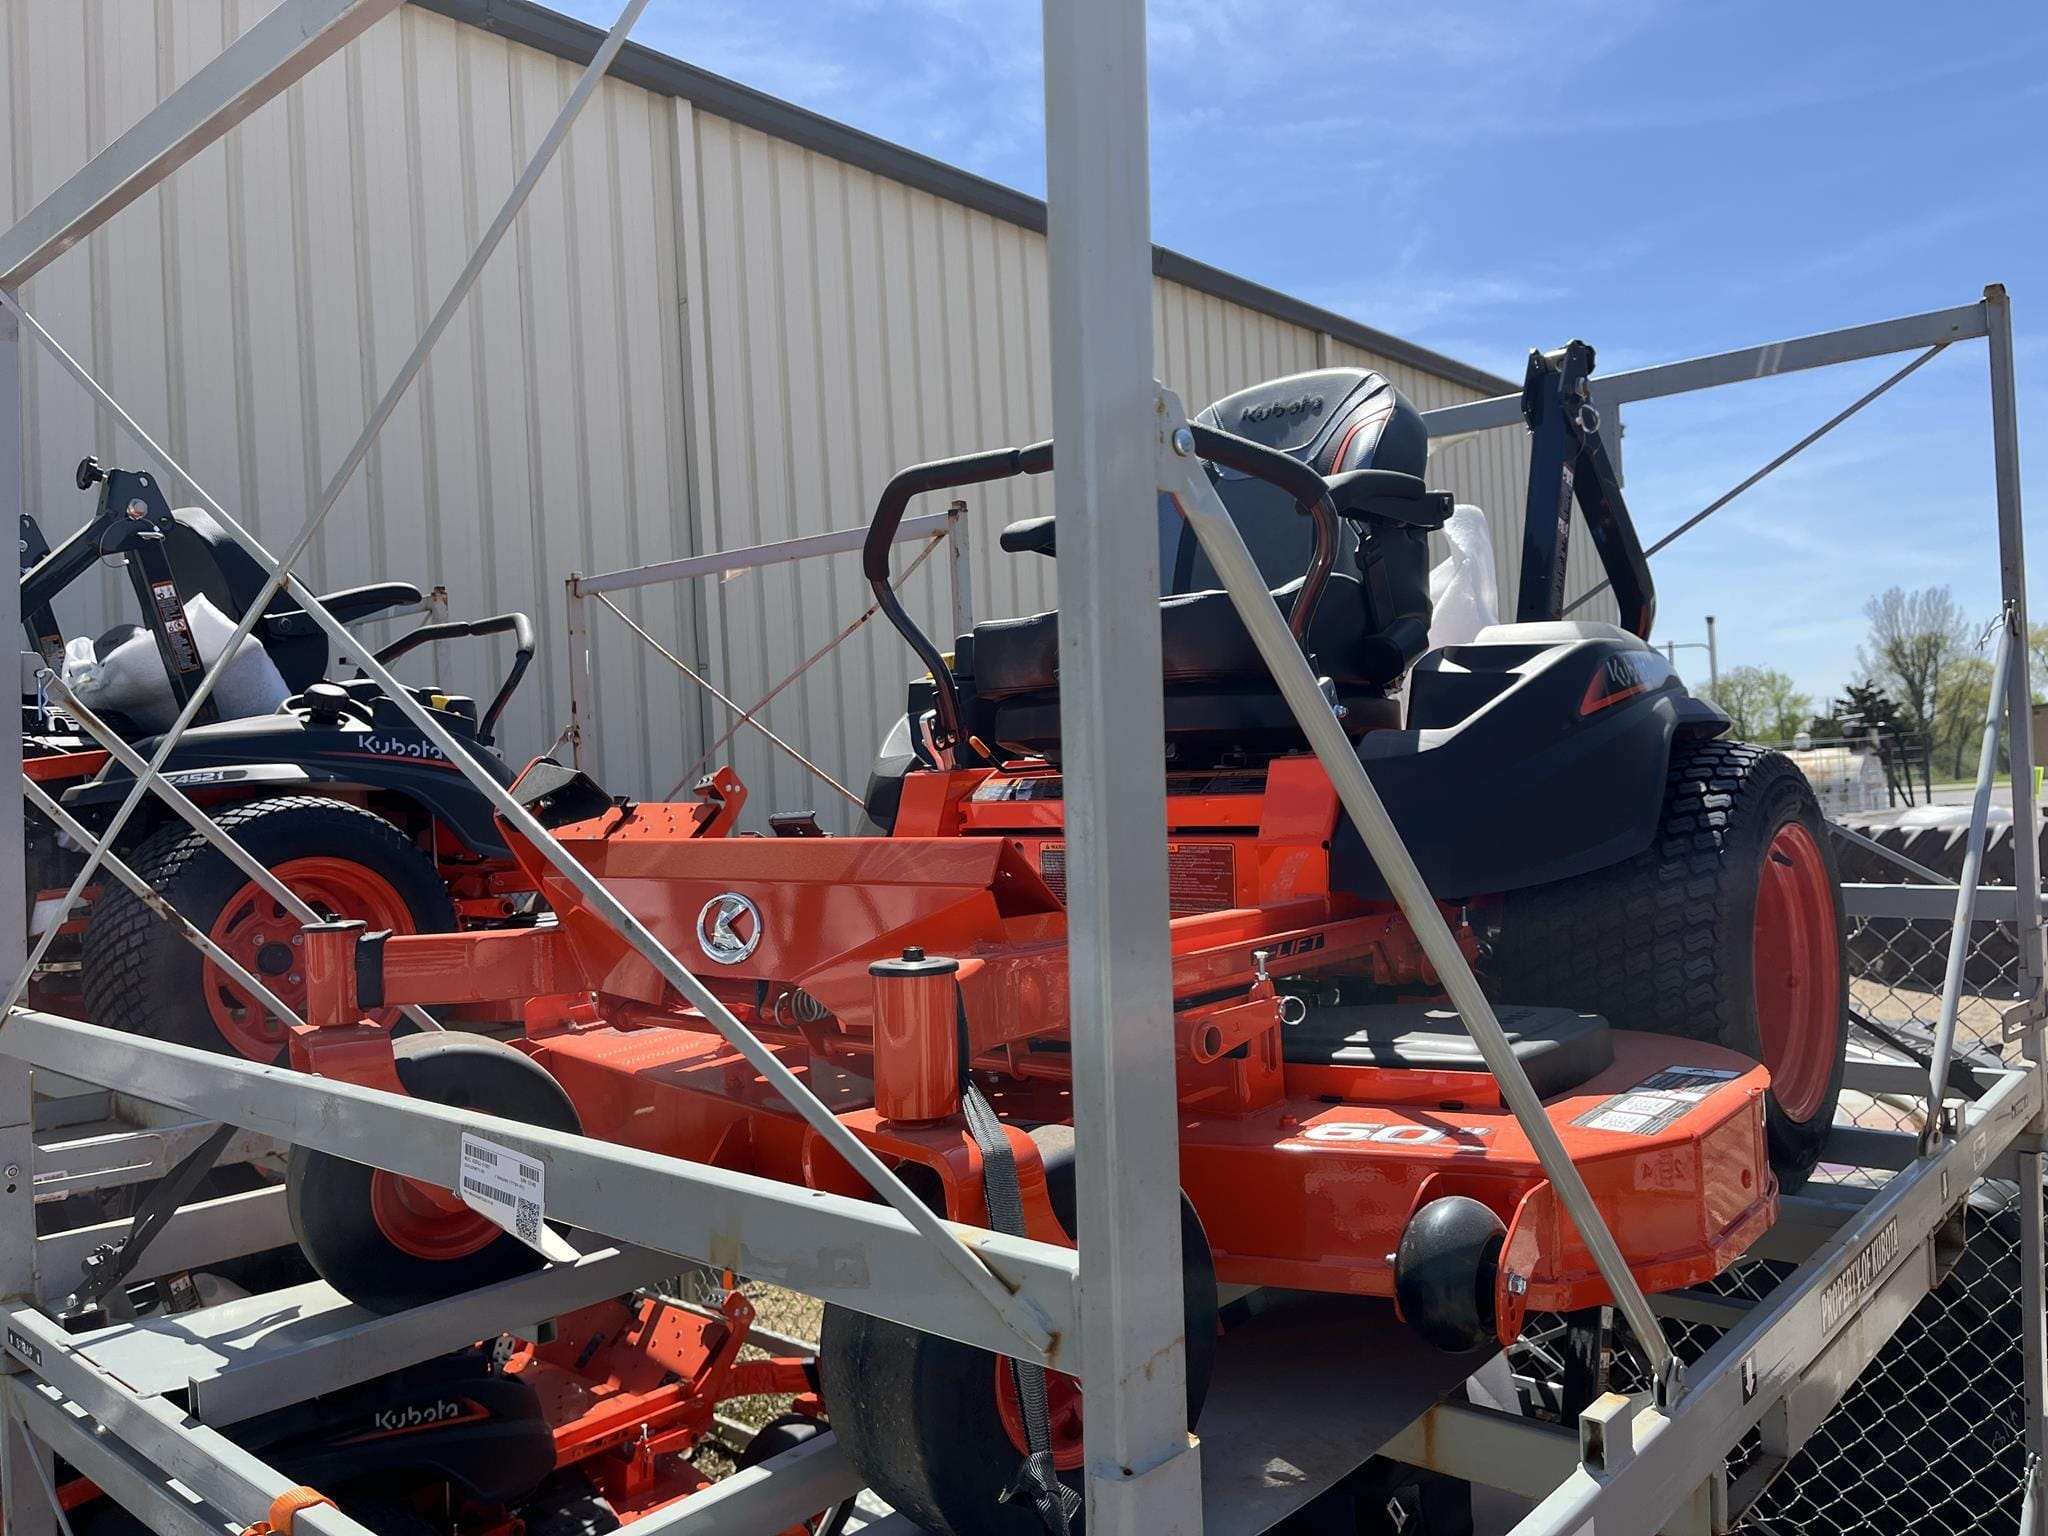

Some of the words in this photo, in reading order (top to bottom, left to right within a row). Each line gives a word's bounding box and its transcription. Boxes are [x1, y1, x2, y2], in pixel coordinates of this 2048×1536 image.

[1242, 395, 1324, 423] Kubota
[358, 735, 443, 760] Kubota
[1821, 1256, 1861, 1334] PROPERTY
[1861, 1247, 1871, 1289] OF
[1871, 1219, 1899, 1278] KUBOTA
[375, 1399, 459, 1431] Kubota
